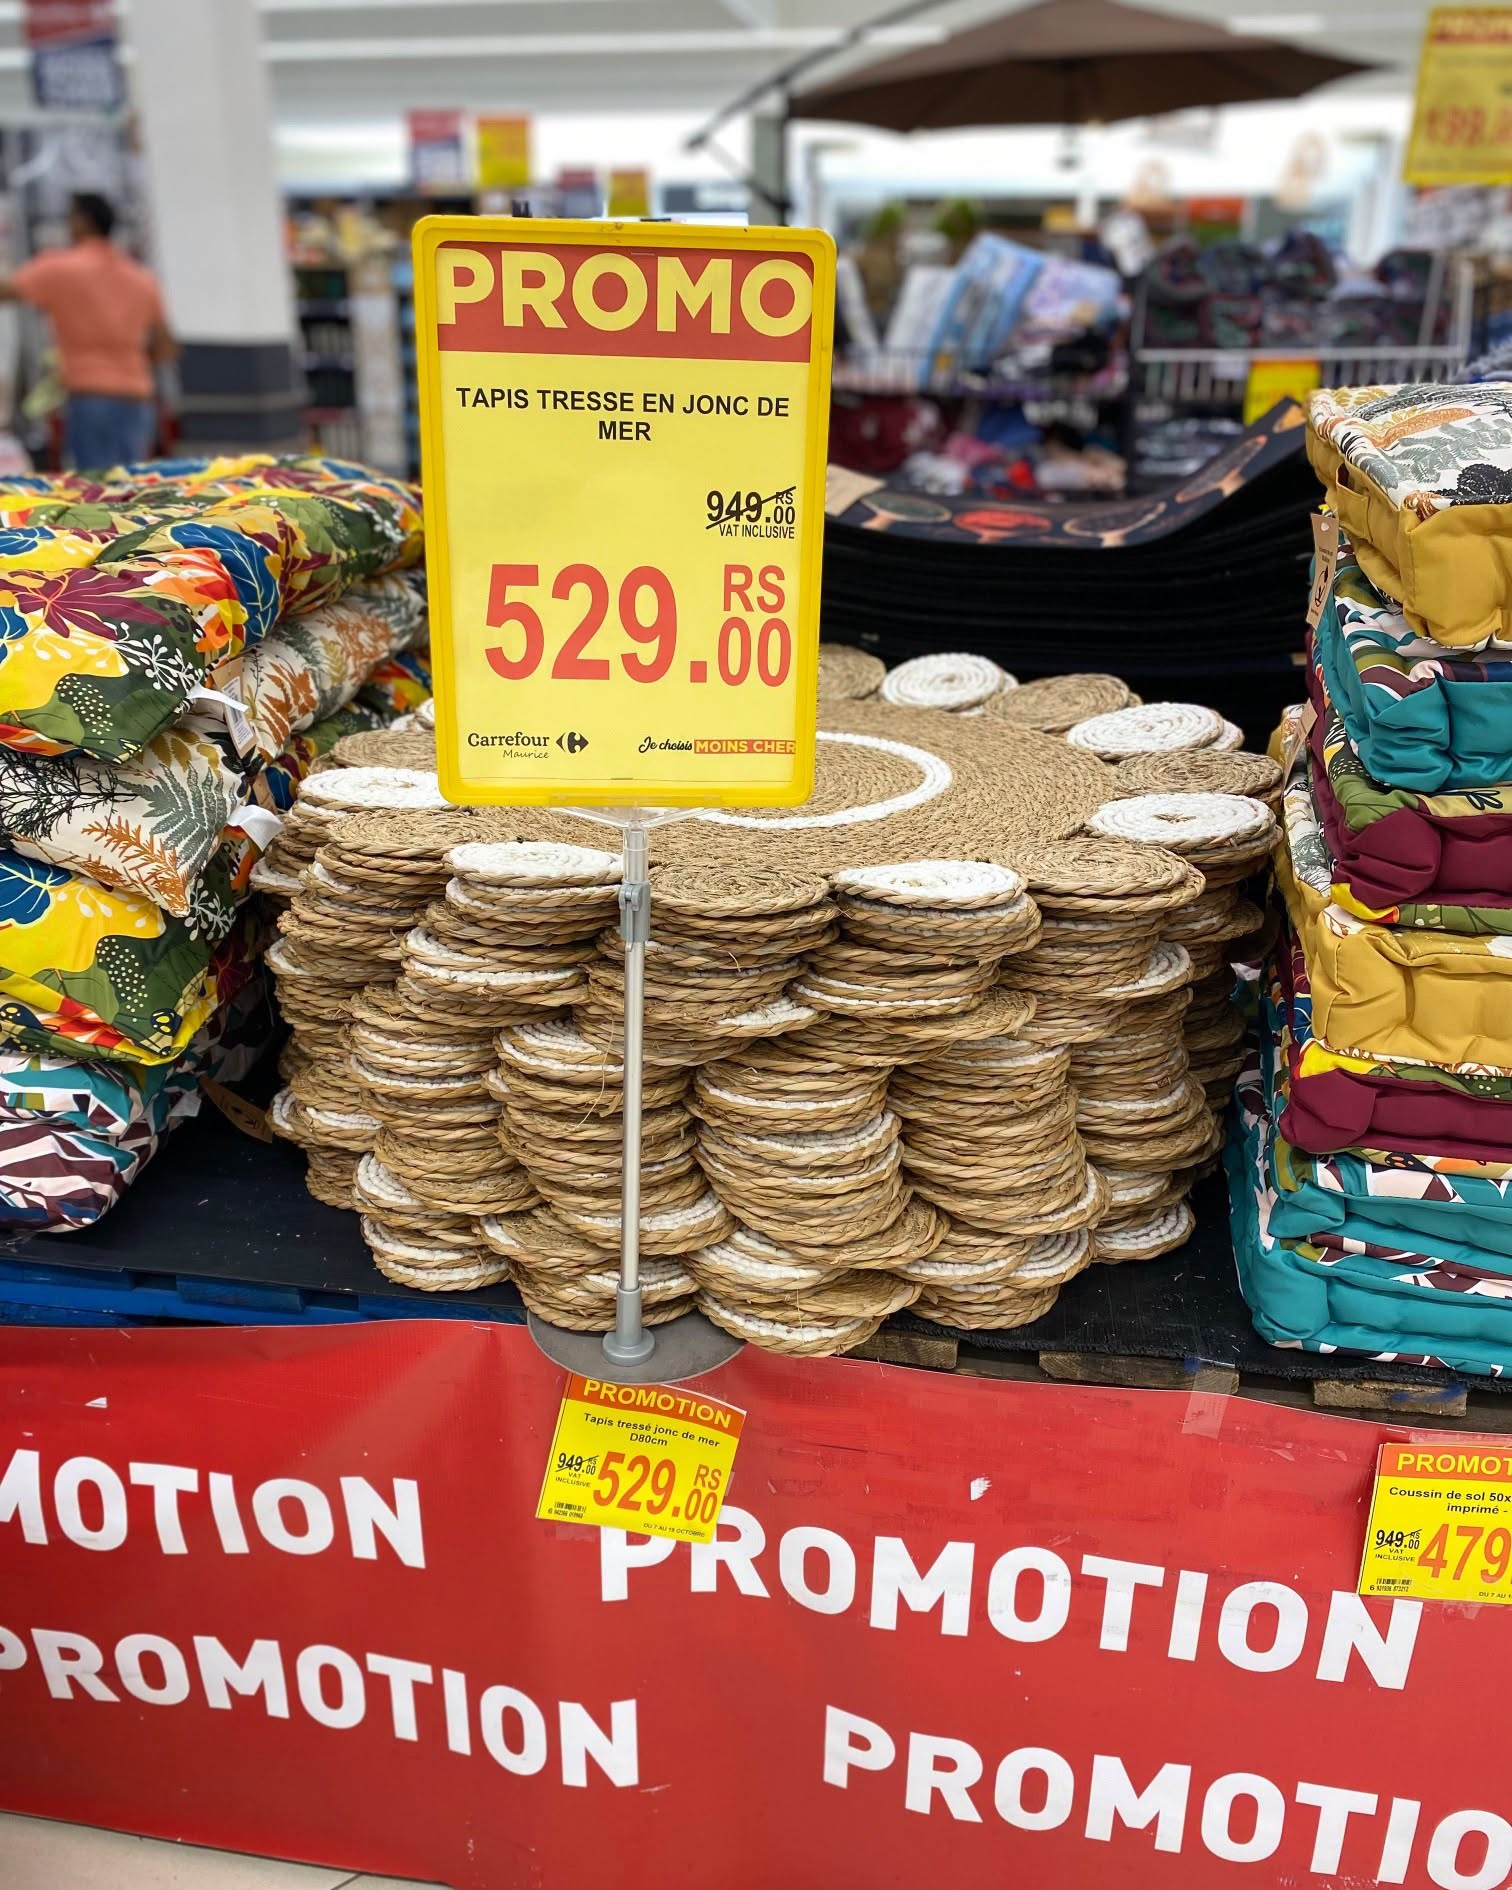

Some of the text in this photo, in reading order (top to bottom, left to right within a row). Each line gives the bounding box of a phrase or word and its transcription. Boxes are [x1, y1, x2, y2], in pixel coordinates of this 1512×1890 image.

[437, 248, 813, 337] PROMO
[456, 387, 790, 417] TAPIS TRESSE EN JONC DE
[598, 420, 651, 441] MER
[719, 523, 795, 539] VAT INCLUSIVE
[723, 564, 785, 614] RS
[467, 731, 549, 747] Carrefour
[638, 735, 796, 753] Je choisis MOINS CHER
[503, 749, 550, 760] Maurice
[583, 1378, 732, 1429] PROMOTION
[584, 1413, 720, 1448] Tapis tressé jonc de mer
[629, 1432, 668, 1446] D80cm
[555, 1476, 591, 1487] INCLUSIVE
[694, 1463, 722, 1491] RS
[1389, 1486, 1512, 1502] Coussin de sol 50x
[1446, 1503, 1499, 1515] imprimé
[1375, 1553, 1415, 1562] INCLUSIVE
[601, 1505, 1424, 1690] PROMOTION
[823, 1705, 1512, 1890] PROMOTIO
